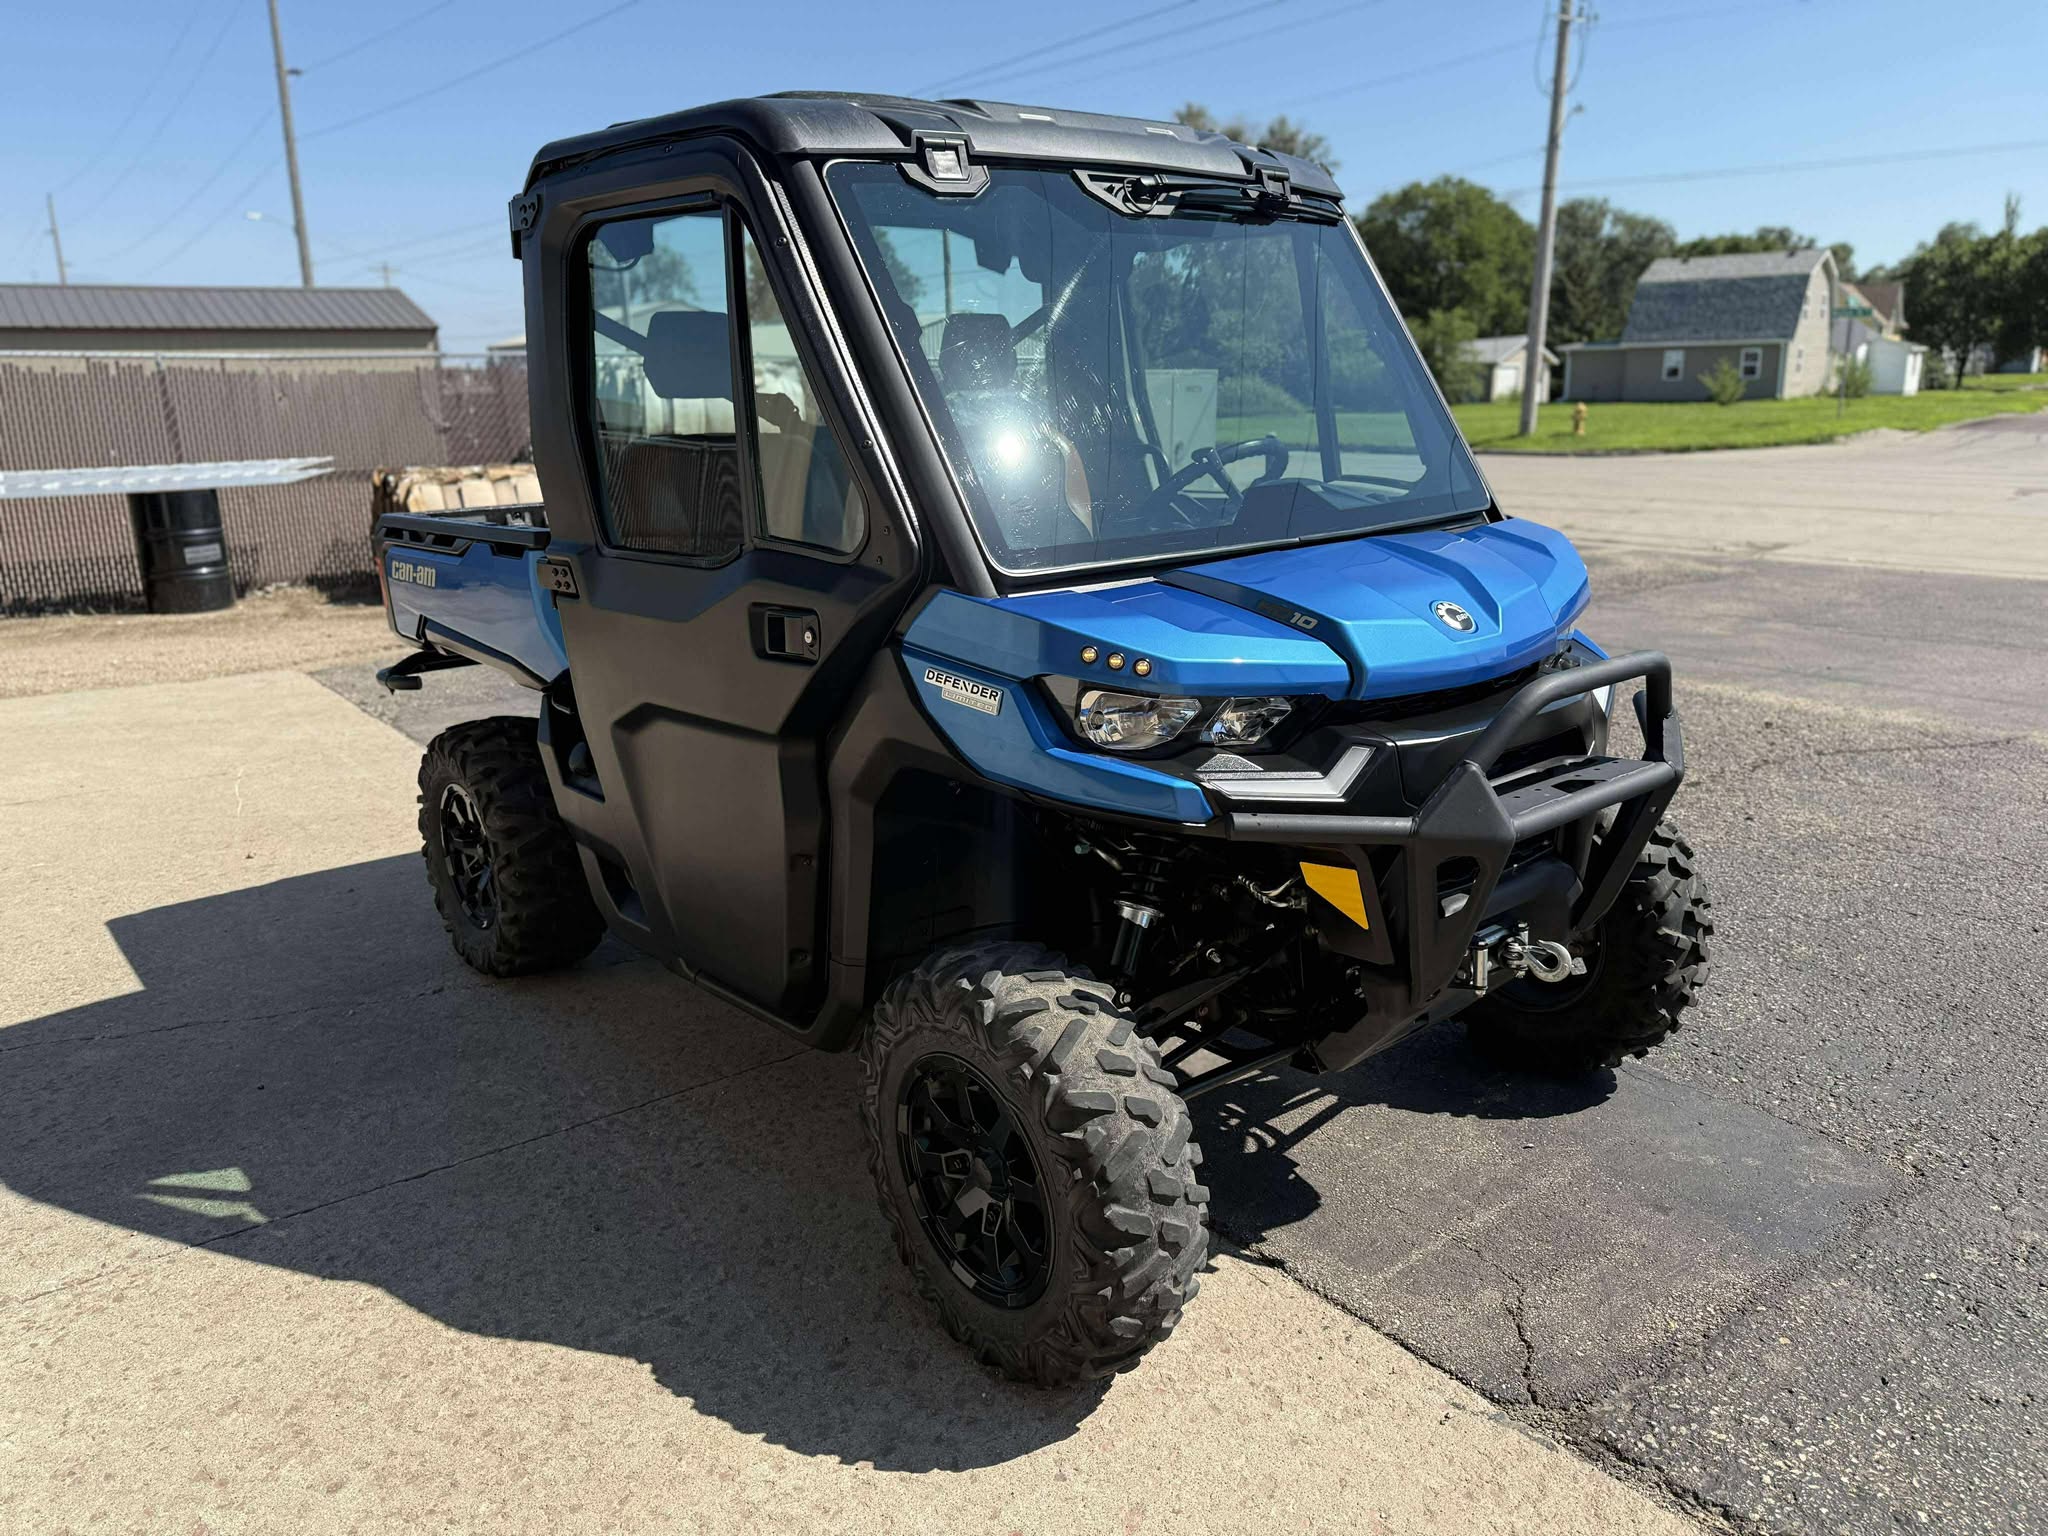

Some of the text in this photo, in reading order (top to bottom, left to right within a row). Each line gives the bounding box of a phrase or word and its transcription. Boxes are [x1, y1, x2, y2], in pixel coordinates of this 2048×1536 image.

[391, 560, 436, 588] can-am
[1290, 612, 1318, 630] 10
[926, 669, 999, 701] DEFENDER
